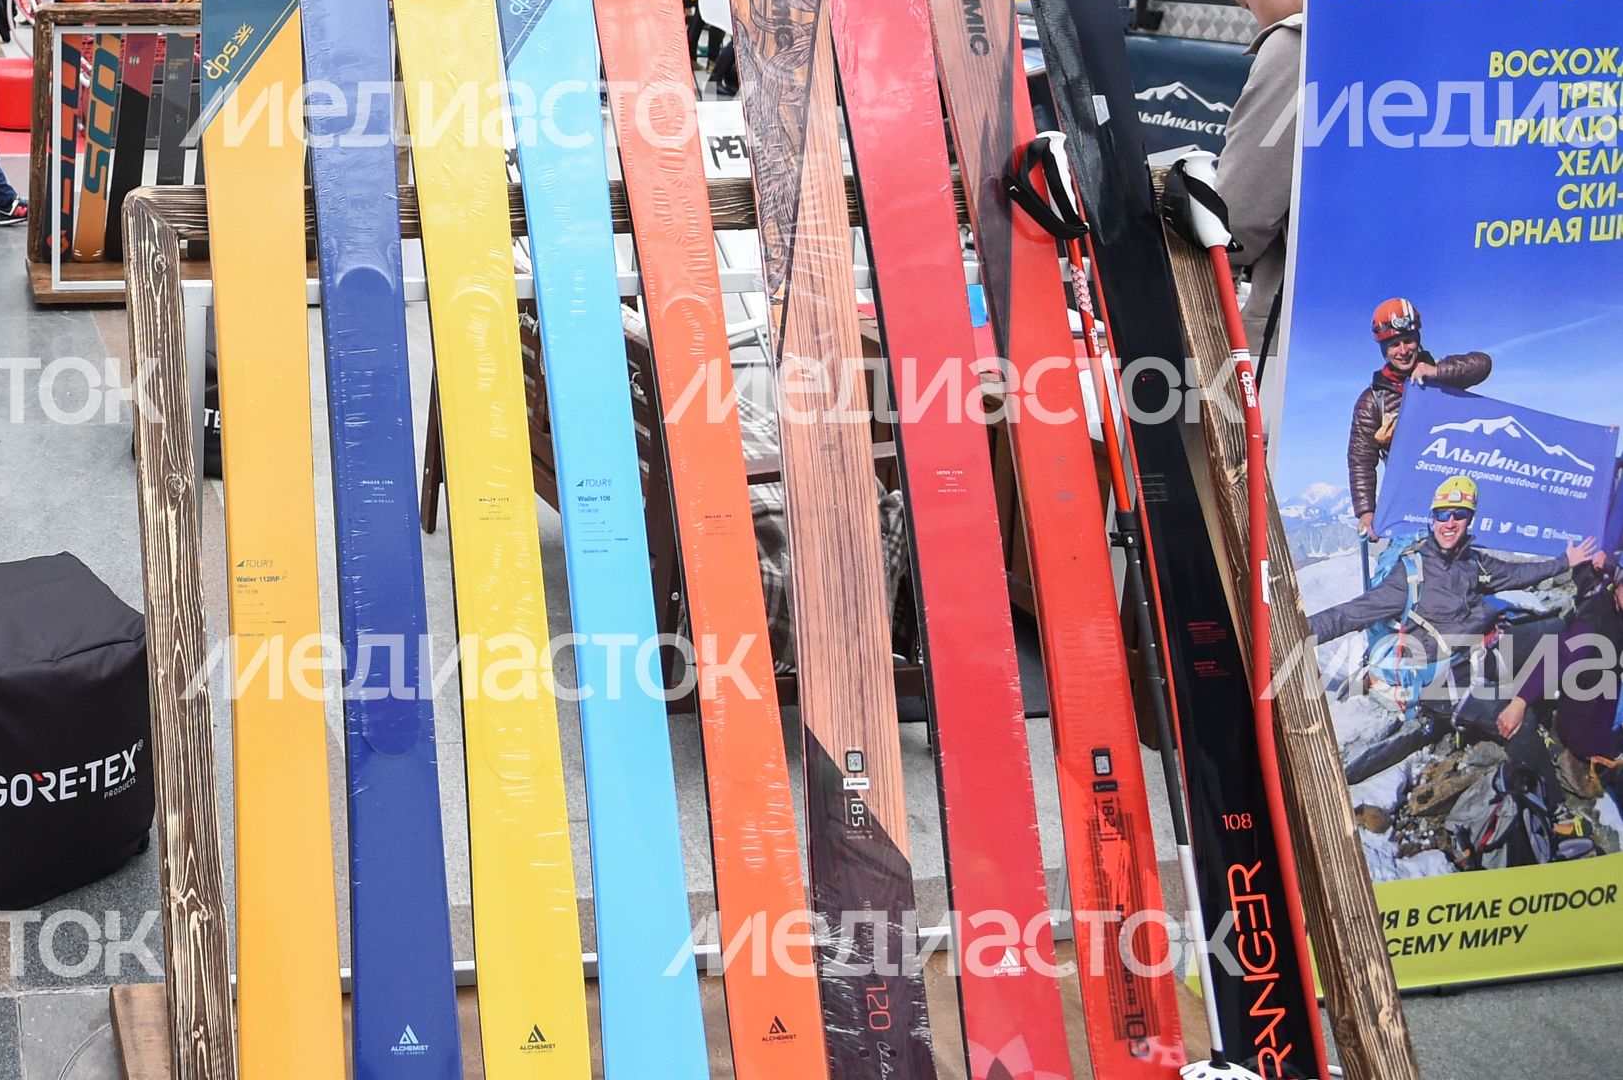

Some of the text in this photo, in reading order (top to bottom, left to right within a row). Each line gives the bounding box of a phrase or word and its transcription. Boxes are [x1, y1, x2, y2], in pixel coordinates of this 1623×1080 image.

[206, 41, 240, 80] dps
[1489, 47, 1623, 78] ВОСХОЖ
[1558, 81, 1623, 109] ТРЕК
[1138, 111, 1227, 137] ЬПИНДУСТ
[1474, 216, 1583, 249] ГОРНАЯ
[1240, 371, 1254, 394] dps
[1415, 460, 1459, 477] Эксперт
[1504, 476, 1540, 491] outdoor
[1549, 483, 1569, 496] 1988
[236, 575, 257, 583] Wailer
[103, 774, 137, 800] PRODUCTS
[850, 796, 865, 827] 185
[1101, 797, 1116, 827] 182
[1222, 813, 1252, 831] 108
[1407, 908, 1420, 928] В
[1426, 899, 1502, 925] СТИЛЕ
[1508, 883, 1618, 916] OUTDOOR
[1459, 924, 1529, 950] МИРУ
[1227, 860, 1294, 1080] RANGER
[865, 980, 892, 1031] 120
[519, 1043, 556, 1051] ALCHEMIST
[761, 1034, 797, 1042] ALCHEMIST
[1122, 1008, 1151, 1058] 109
[391, 1044, 429, 1052] ALCHEMIST
